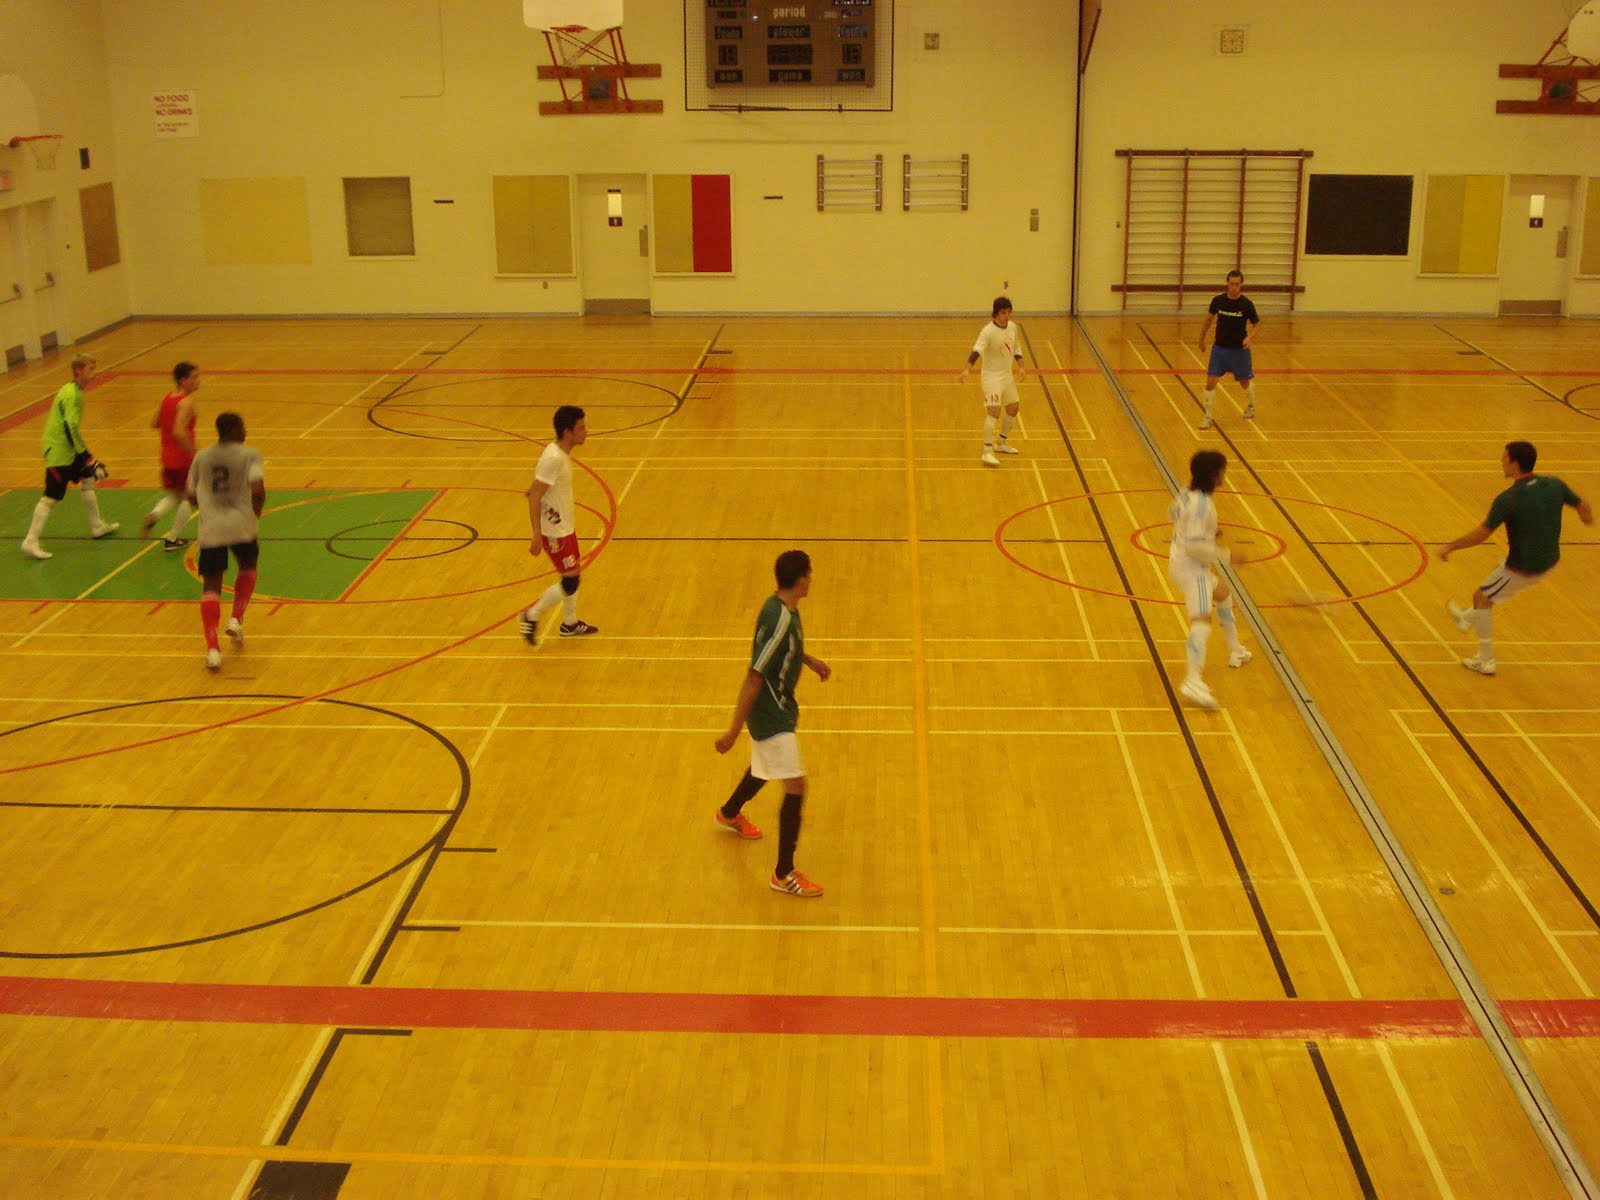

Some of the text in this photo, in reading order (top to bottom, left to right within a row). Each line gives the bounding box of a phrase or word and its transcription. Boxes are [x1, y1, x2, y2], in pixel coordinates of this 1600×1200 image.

[773, 5, 806, 19] period
[167, 94, 189, 102] FOOD
[212, 465, 230, 493] 2
